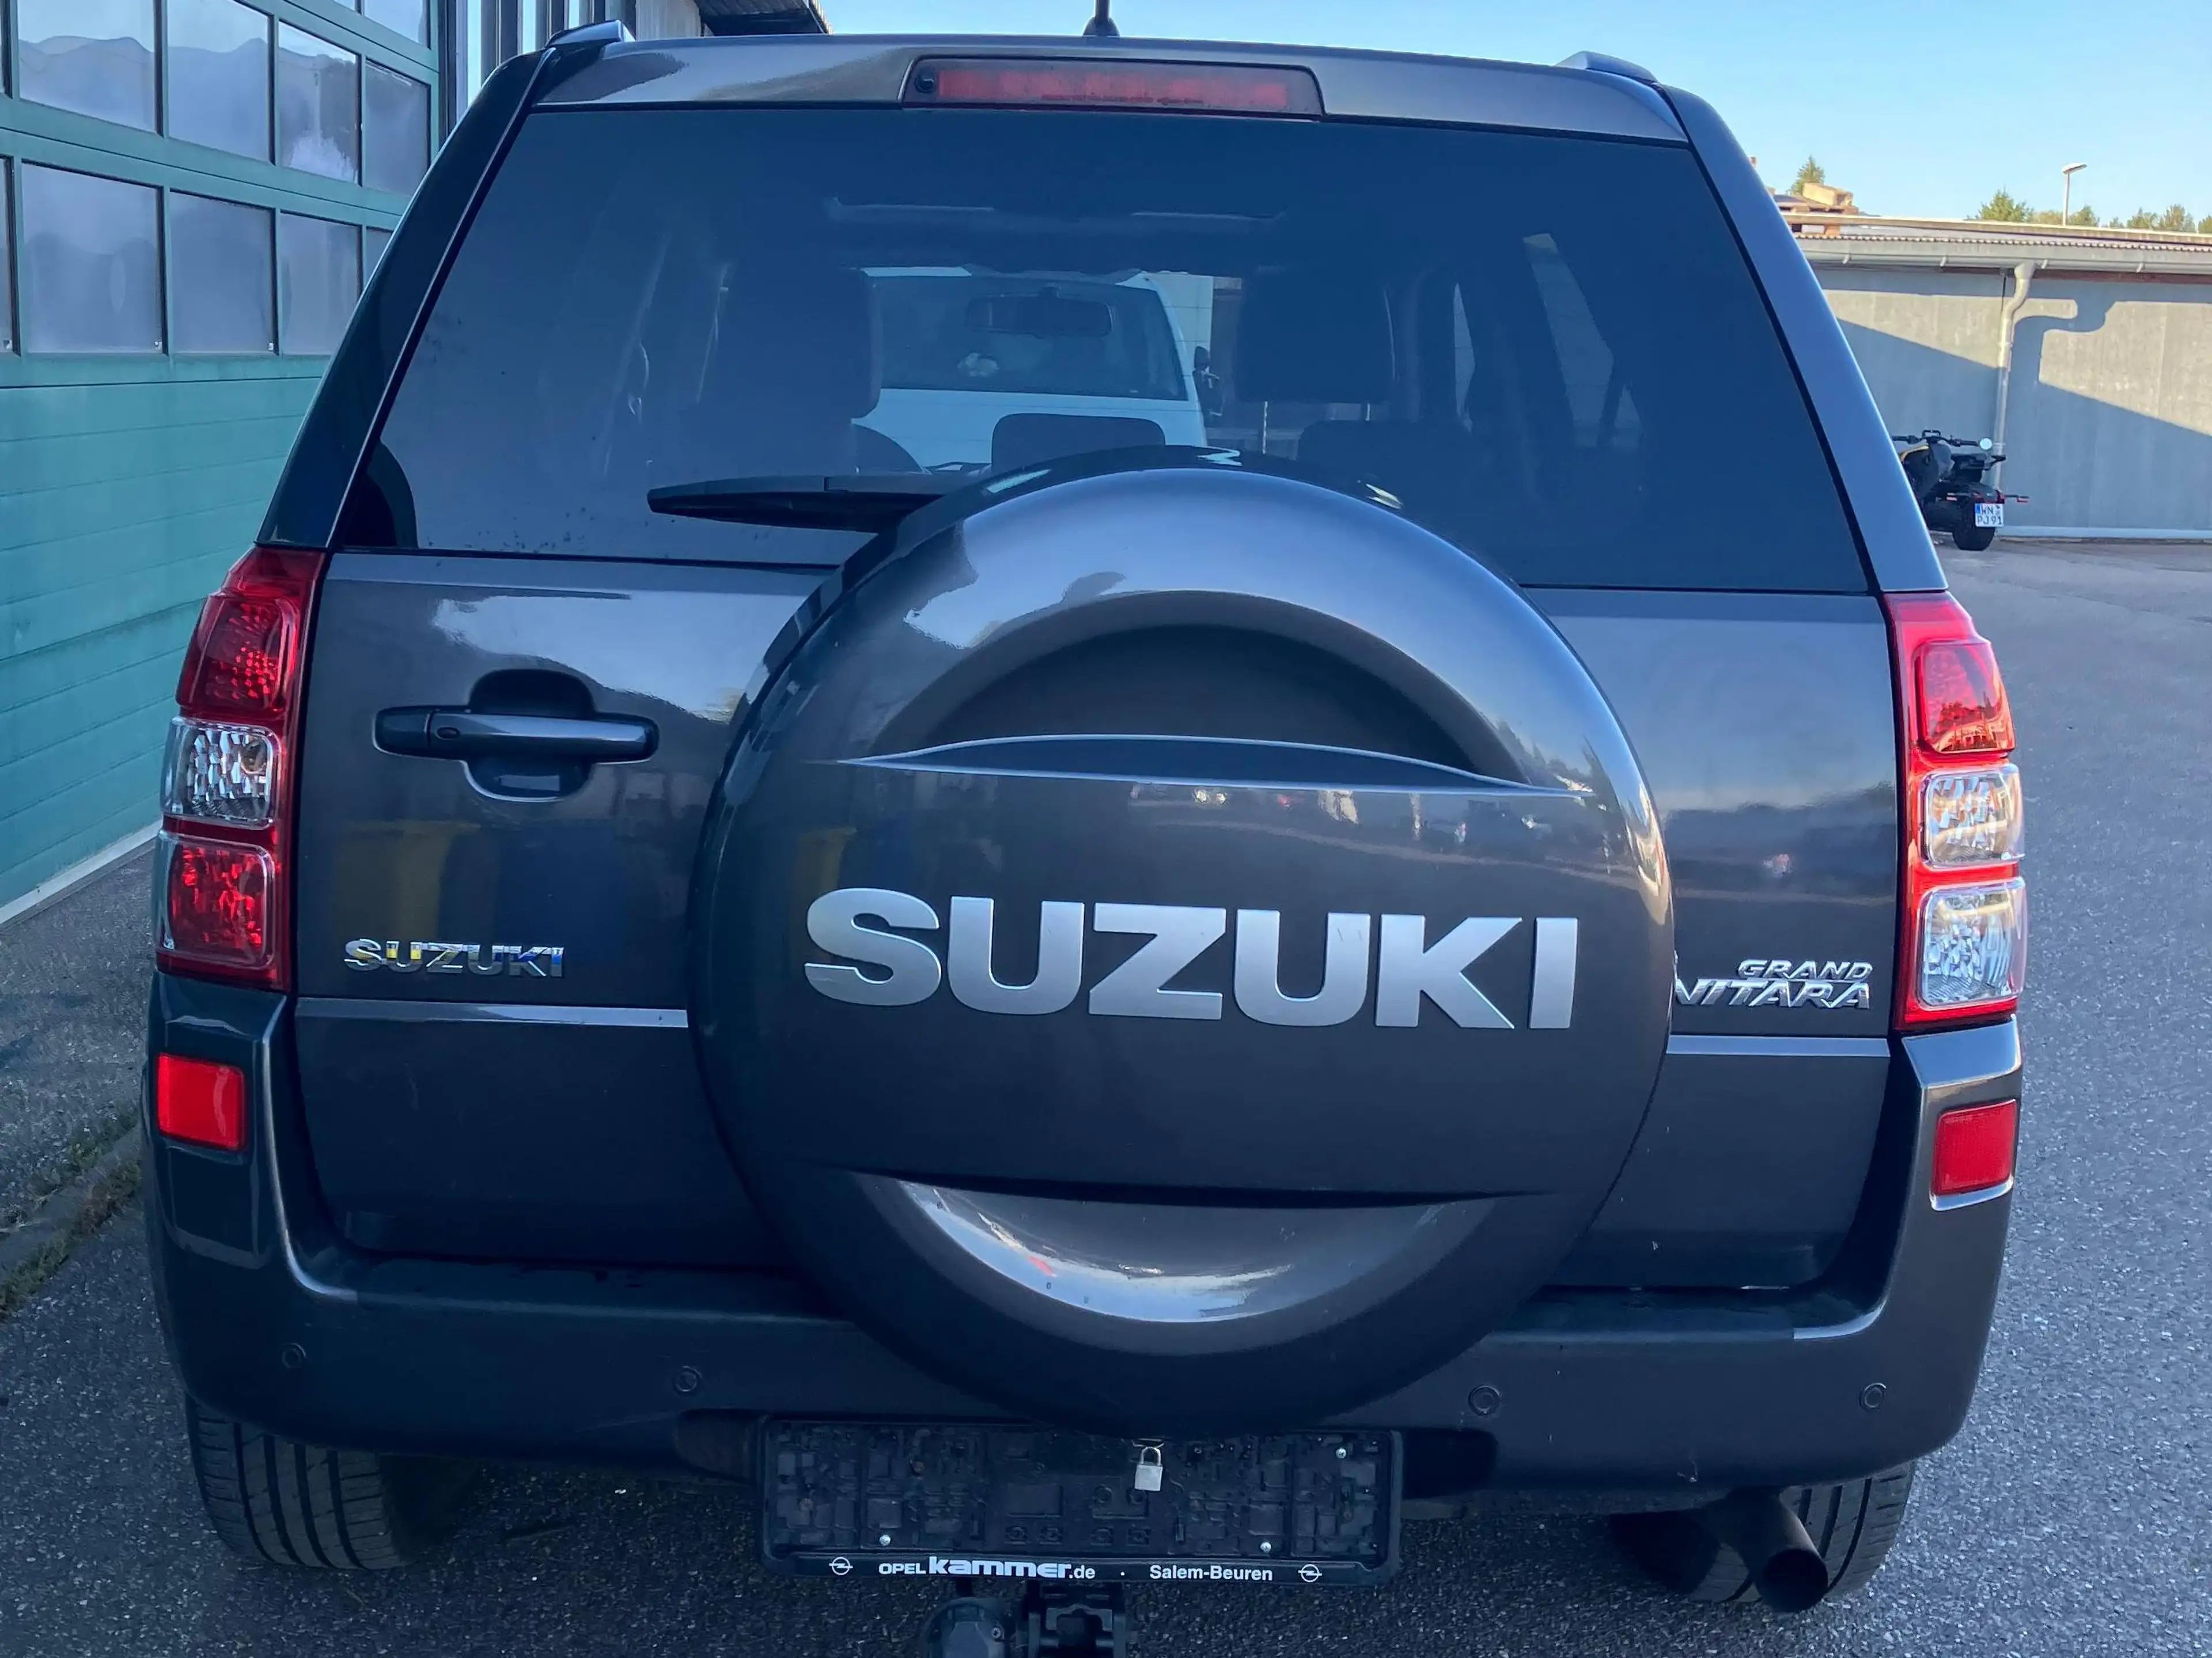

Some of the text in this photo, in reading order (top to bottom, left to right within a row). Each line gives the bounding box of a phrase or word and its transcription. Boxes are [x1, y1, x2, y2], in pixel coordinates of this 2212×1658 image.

[344, 938, 565, 978] SUZUKI
[805, 887, 1578, 1029] SUZUKI
[1737, 959, 1873, 980] GRAND
[1675, 979, 1870, 1009] VITARA
[878, 1557, 1273, 1581] OPEL kammer.de Salem-Beuren
